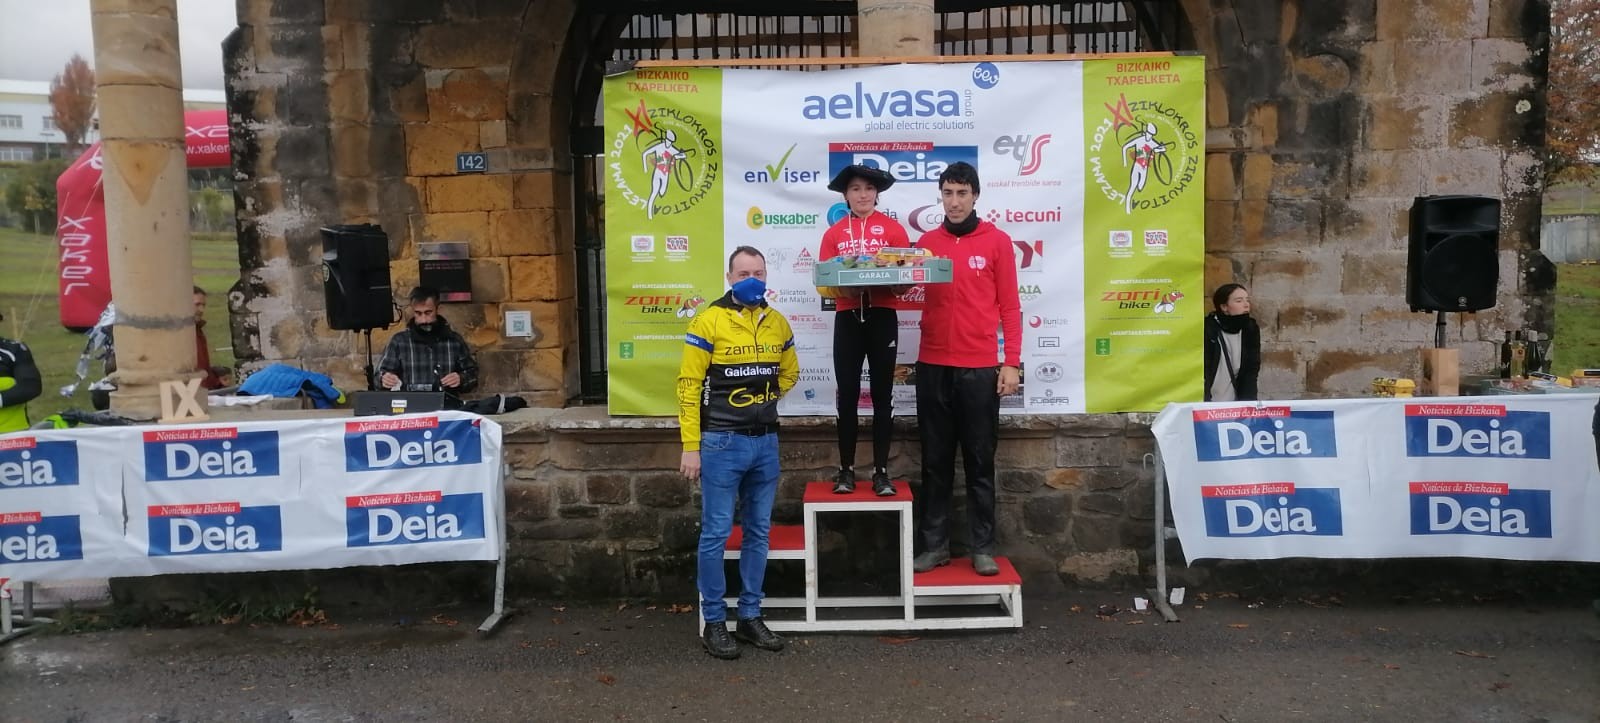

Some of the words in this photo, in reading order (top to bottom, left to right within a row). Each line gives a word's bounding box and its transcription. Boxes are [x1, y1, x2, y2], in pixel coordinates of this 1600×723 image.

[1116, 61, 1170, 73] BIZKAIKO
[636, 71, 689, 81] BIZKAIKO
[1106, 74, 1180, 86] TXAPELKETA
[626, 82, 698, 93] TXAPELKETA
[802, 82, 960, 120] aelvasa
[965, 89, 974, 118] group
[648, 108, 717, 156] ZIKLOKROS
[864, 120, 894, 132] global
[896, 120, 930, 130] electric
[932, 120, 974, 130] solutions
[1128, 100, 1198, 150] ZIKLOKROS
[611, 124, 632, 158] 2021
[1090, 118, 1114, 152] 2021
[843, 143, 879, 152] Noticias
[892, 142, 928, 151] Bizkaia
[460, 155, 484, 170] 142
[609, 162, 648, 210] LEZAMA
[1089, 156, 1126, 206] LEZAMA
[1132, 155, 1198, 210] ZIRKUITOA
[653, 162, 718, 216] ZIRKUITOA
[1005, 206, 1061, 222] tecuni
[859, 271, 891, 280] GARAIA
[779, 288, 806, 296] Silicatos
[1018, 285, 1042, 294] AIA
[1102, 288, 1160, 302] zorri
[624, 293, 683, 306] zorri
[790, 296, 816, 304] Malpica
[1119, 302, 1150, 310] bike
[641, 306, 672, 314] bike
[724, 342, 783, 356] zamakoa
[724, 366, 772, 377] Galdakao
[728, 380, 778, 408] Gela
[1206, 410, 1241, 420] Noticias
[1242, 409, 1250, 418] de
[1251, 407, 1285, 418] Bizkaia
[1418, 405, 1451, 415] Noticias
[1454, 406, 1464, 415] de
[1465, 406, 1500, 416] Bizkaia
[358, 422, 390, 432] Noticias
[390, 420, 400, 430] de
[400, 418, 433, 429] Bizkaia
[156, 431, 189, 441] Noticias
[190, 430, 200, 440] de
[200, 429, 232, 440] Bizkaia
[1217, 420, 1312, 458] Deia
[1428, 418, 1526, 456] Deia
[366, 430, 458, 468] Deia
[165, 440, 257, 478] Deia
[0, 450, 56, 486] eia
[1214, 486, 1250, 496] Noticias
[1251, 485, 1260, 495] de
[1262, 484, 1289, 494] Bizkaia
[1422, 483, 1451, 493] Noticias
[1452, 484, 1463, 492] de
[1464, 484, 1502, 494] Bizkaia
[358, 496, 392, 506] Noticias
[392, 494, 402, 504] de
[404, 492, 436, 504] Bizkaia
[160, 506, 192, 516] Noticias
[192, 505, 202, 514] de
[203, 504, 236, 514] Bizkaia
[1225, 496, 1317, 534] Deia
[1429, 496, 1530, 534] Deia
[368, 504, 462, 543] Deia
[170, 515, 260, 552] Deia
[0, 524, 60, 561] eia
